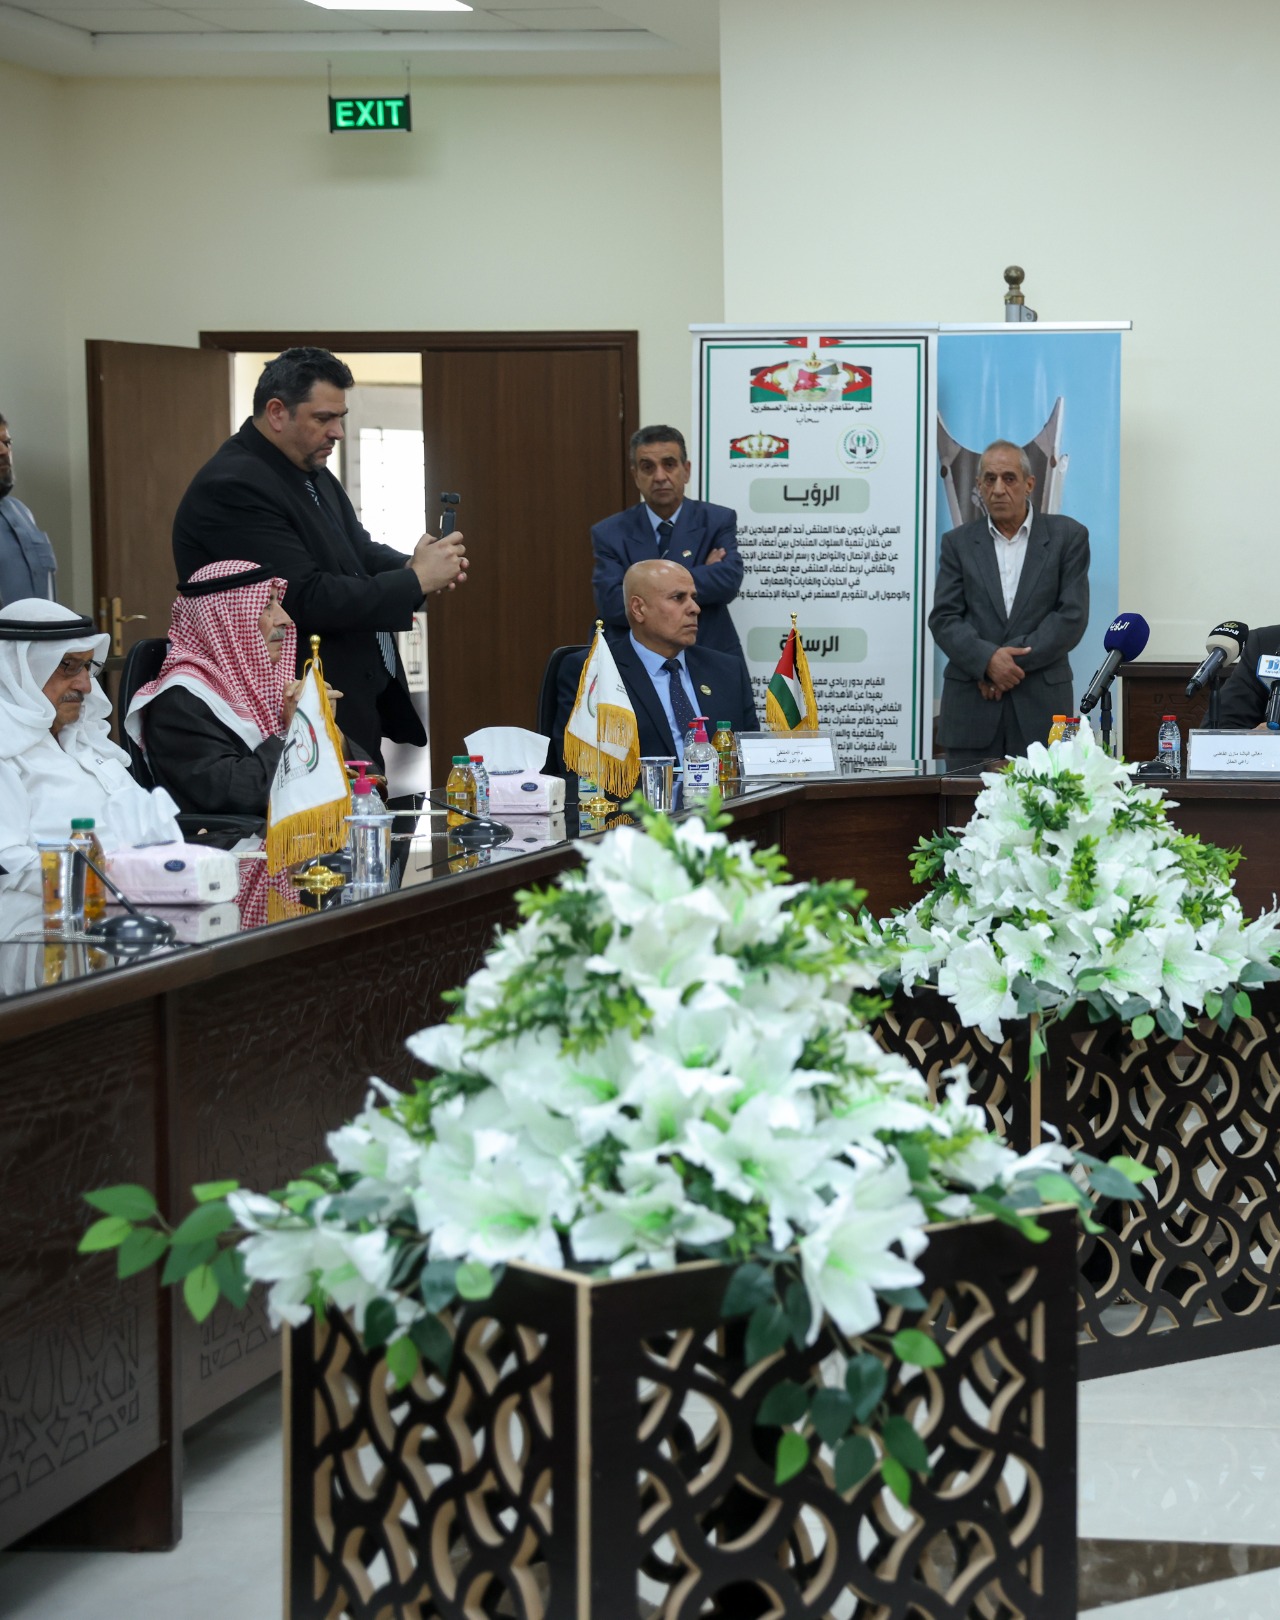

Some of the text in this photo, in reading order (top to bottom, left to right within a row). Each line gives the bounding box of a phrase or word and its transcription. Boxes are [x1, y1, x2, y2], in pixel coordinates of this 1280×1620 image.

[335, 100, 404, 127] EXIT
[856, 404, 872, 413] ملتقى
[750, 526, 776, 536] الميادين
[806, 526, 832, 536] الملتقى
[832, 526, 846, 536] هذا
[847, 526, 866, 536] يكون
[866, 526, 877, 536] لأن
[878, 526, 900, 536] السعي
[777, 538, 789, 549] بين
[790, 538, 818, 549] المتبادل
[818, 538, 844, 549] السلوك
[844, 538, 864, 549] تنمية
[864, 538, 880, 549] خلال
[881, 538, 892, 549] من
[758, 552, 782, 562] التفاعل
[795, 552, 810, 562] رسم
[816, 552, 846, 562] والتواصل
[872, 552, 887, 562] طرق
[888, 552, 898, 562] عن
[772, 564, 788, 575] بعض
[790, 564, 800, 575] مع
[802, 564, 828, 575] الملتقى
[848, 564, 864, 575] لربط
[864, 564, 895, 575] والثقافي
[760, 577, 792, 588] والمعارف
[822, 577, 848, 588] الحاجات
[848, 577, 860, 588] في
[780, 590, 800, 602] الحياة
[800, 590, 812, 602] في
[814, 590, 840, 602] المستمر
[840, 590, 868, 602] التقويم
[868, 590, 880, 602] إلى
[880, 590, 910, 602] والوصول
[828, 678, 848, 689] ريادي
[848, 678, 863, 689] بدور
[864, 678, 886, 689] القيام
[825, 690, 854, 701] الأهداف
[854, 690, 865, 701] عن
[865, 690, 883, 701] بعيدا
[874, 702, 902, 714] الثقافي
[832, 715, 856, 727] مشترك
[857, 715, 874, 727] نظام
[875, 715, 898, 727] بتحديد
[852, 728, 884, 739] والثقافية
[854, 742, 876, 754] قنوات
